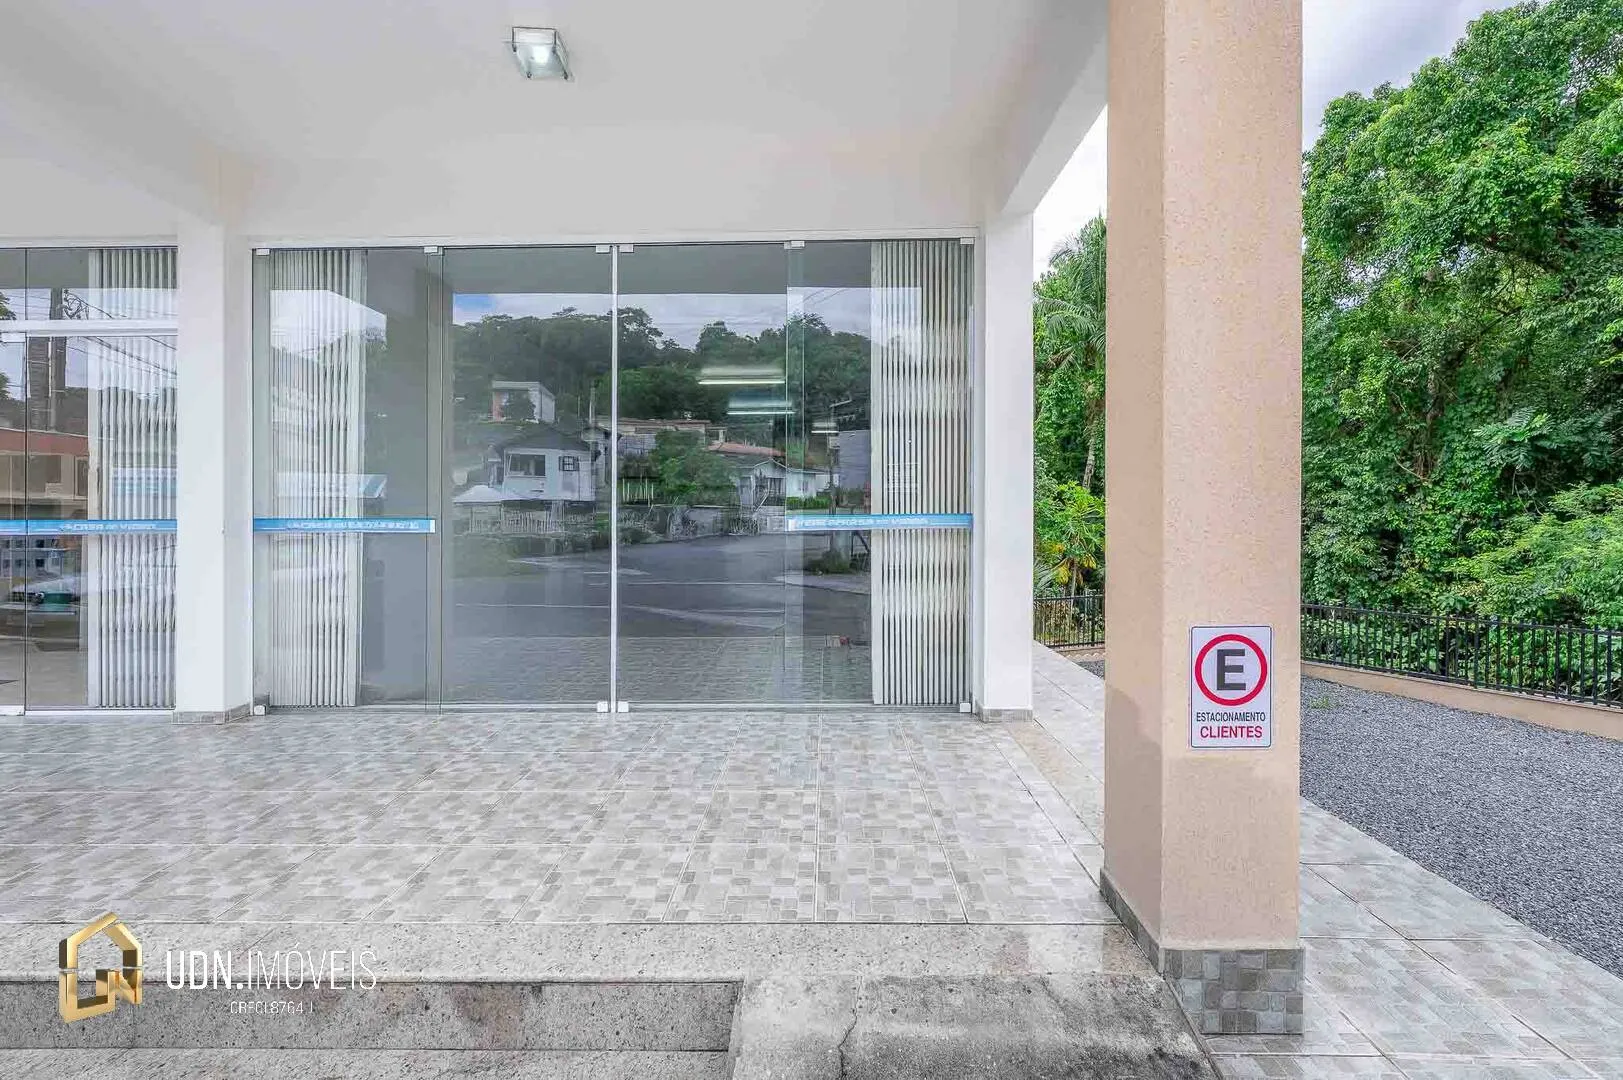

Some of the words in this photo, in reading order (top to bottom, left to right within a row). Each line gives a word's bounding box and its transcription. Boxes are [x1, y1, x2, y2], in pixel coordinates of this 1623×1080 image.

[1217, 648, 1246, 691] E
[1196, 711, 1266, 722] ESTACIONAMENTO
[1200, 725, 1263, 739] CLIENTES
